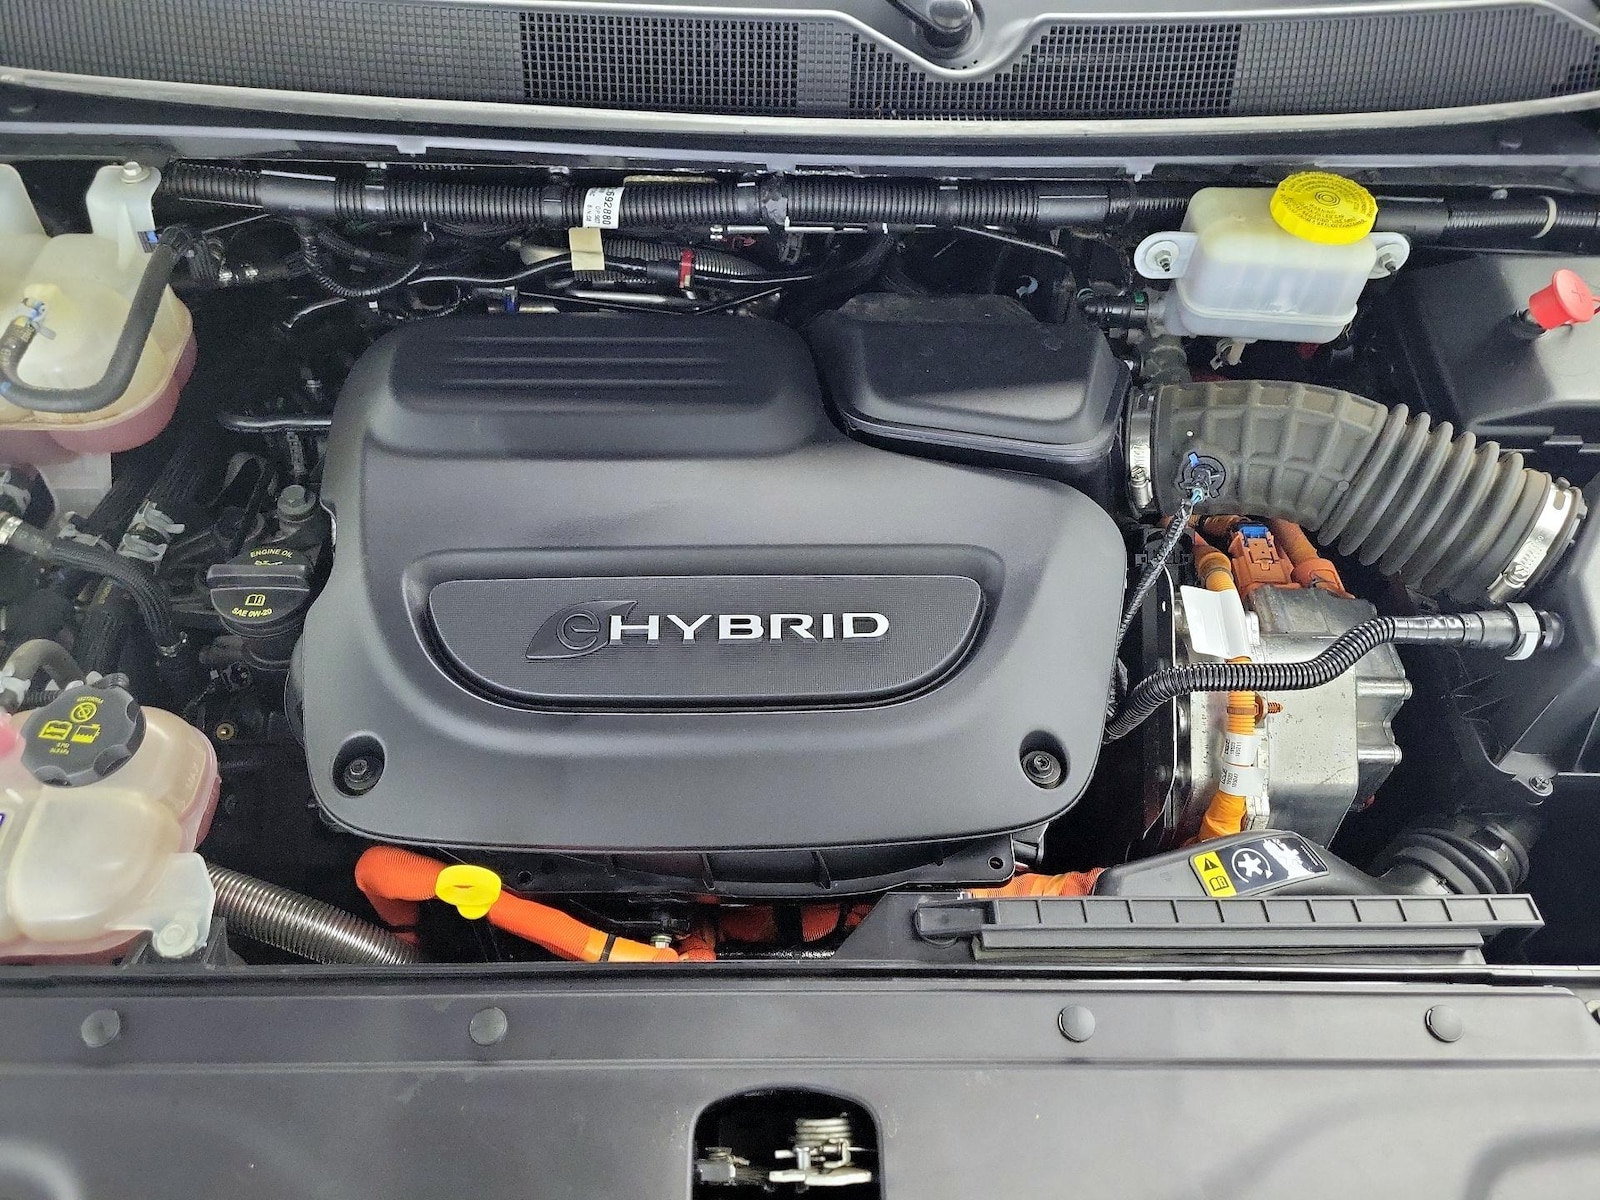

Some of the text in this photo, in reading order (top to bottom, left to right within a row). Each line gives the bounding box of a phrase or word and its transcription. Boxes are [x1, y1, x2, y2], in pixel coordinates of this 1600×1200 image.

[250, 548, 294, 559] ENGINE OIL
[231, 607, 273, 618] SAE 0W-20
